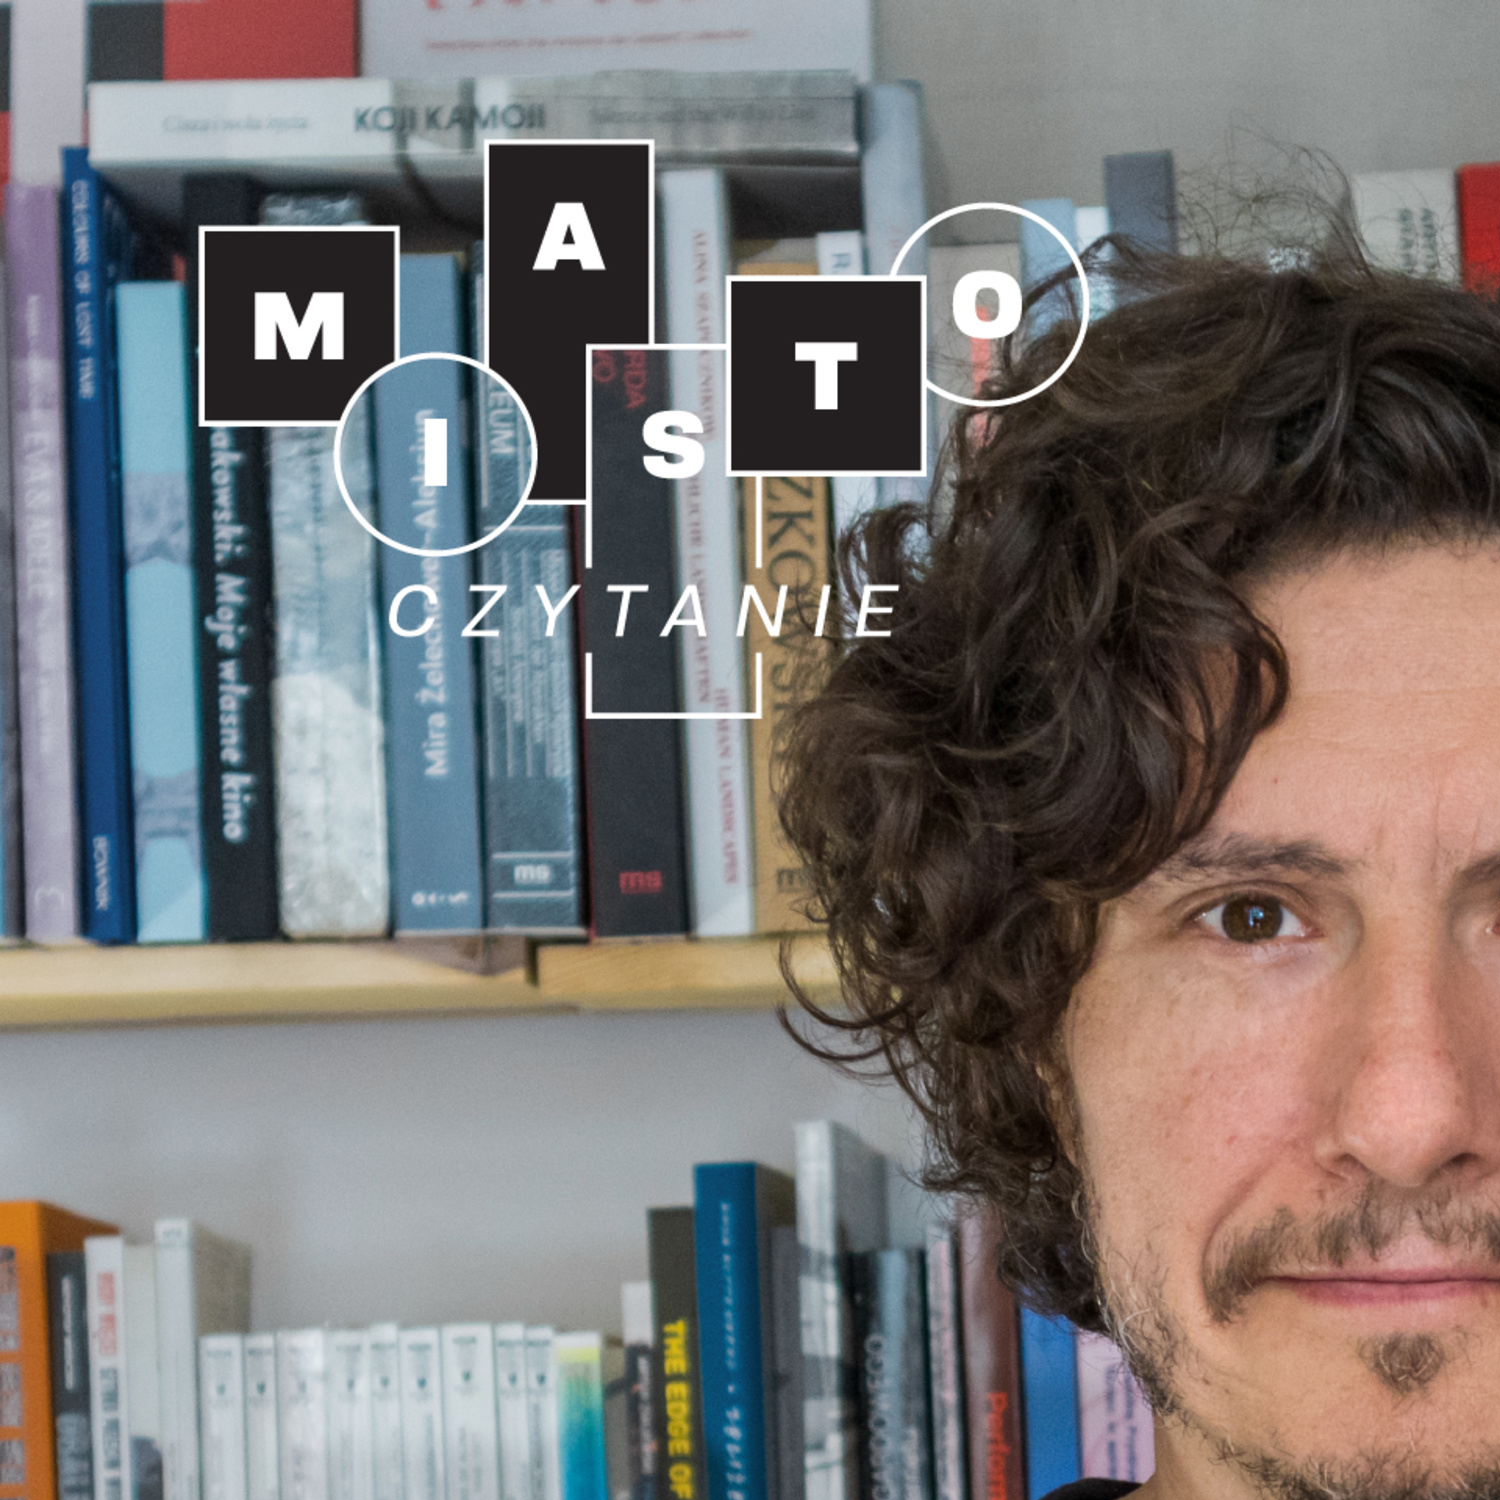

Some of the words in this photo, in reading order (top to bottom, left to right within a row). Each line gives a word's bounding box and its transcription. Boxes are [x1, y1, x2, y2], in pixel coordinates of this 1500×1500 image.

[354, 105, 417, 133] KOJI
[424, 103, 547, 132] KAMOJI
[205, 574, 247, 649] Moje
[219, 660, 251, 763] własne
[423, 709, 450, 778] Mira
[222, 772, 258, 842] kino
[513, 865, 550, 882] ms
[619, 870, 663, 894] ms
[663, 1319, 687, 1376] THE
[664, 1380, 691, 1457] EDGE
[668, 1462, 693, 1500] OF
